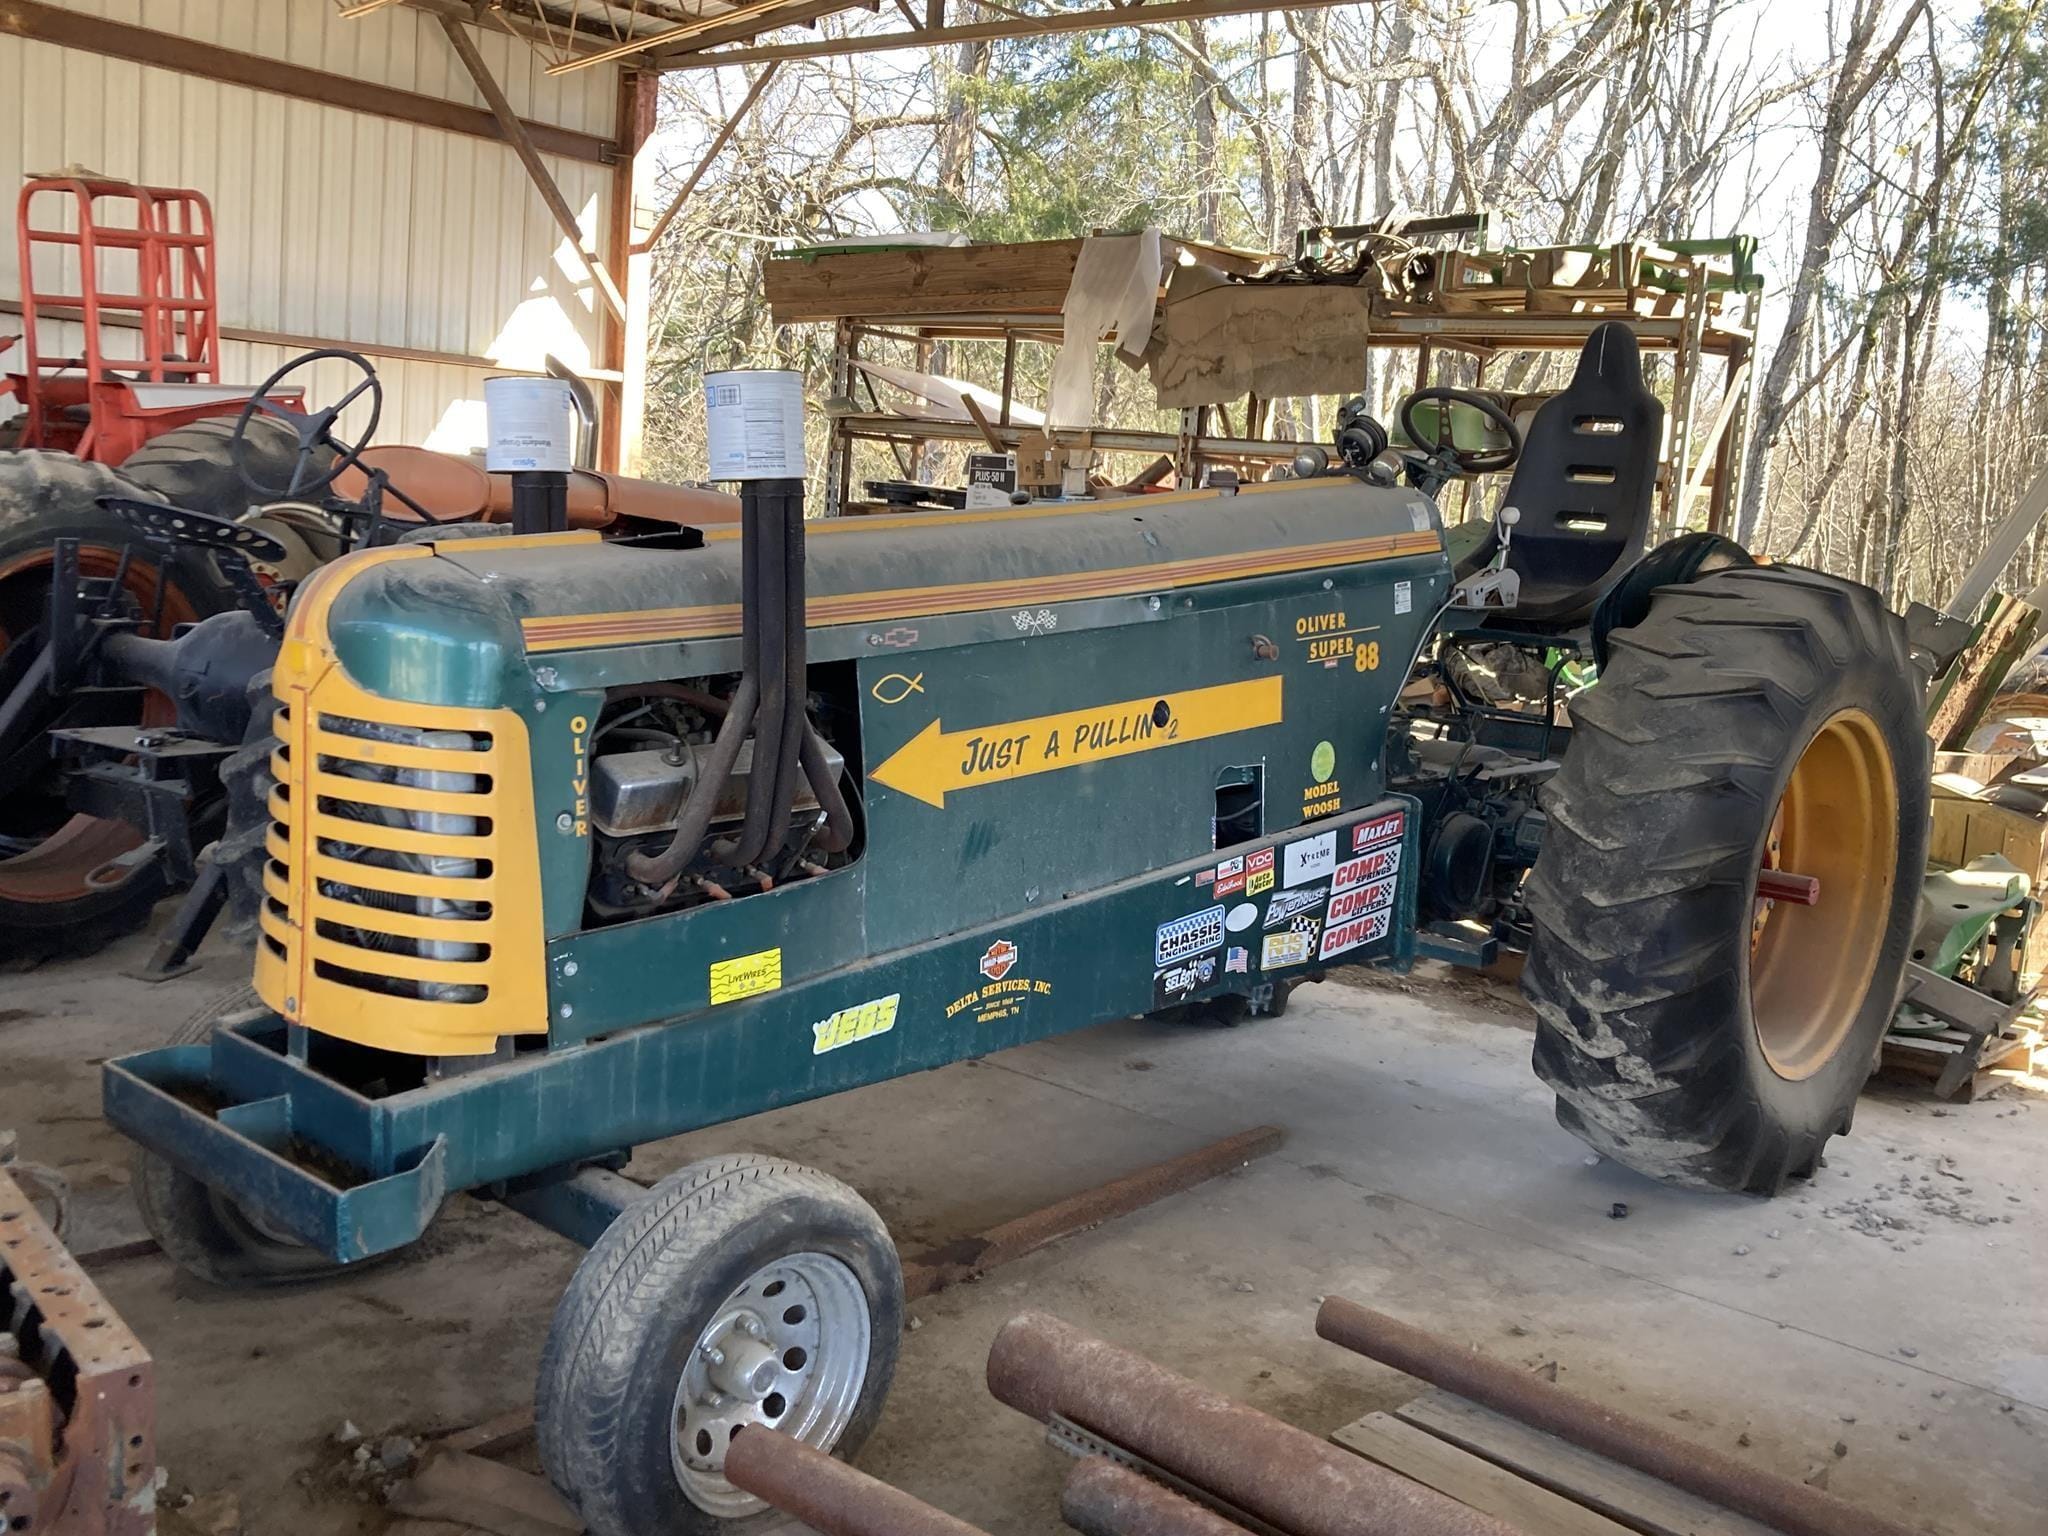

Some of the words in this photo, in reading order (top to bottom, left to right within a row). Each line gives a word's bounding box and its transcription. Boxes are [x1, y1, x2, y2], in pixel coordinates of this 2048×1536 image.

[974, 471, 999, 482] PLUS-50
[1296, 612, 1346, 634] OLIVER
[1310, 637, 1354, 659] SUPER
[1355, 641, 1379, 672] 88
[961, 735, 1030, 775] JUST
[1044, 730, 1059, 759] A
[570, 716, 588, 837] OLIVER
[1304, 781, 1340, 800] MODEL
[1302, 798, 1341, 818] WOOSH
[1248, 852, 1273, 868] VDO
[1335, 853, 1386, 887] COMP
[1356, 864, 1392, 884] SPRINGS
[1330, 885, 1381, 919] COMP
[1352, 897, 1387, 917] LIFTERS
[1160, 921, 1221, 952] CHASSIS
[1160, 933, 1221, 960] ENGINEERING
[1323, 917, 1375, 953] COMP
[1357, 929, 1381, 943] CAMS
[946, 991, 979, 1018] DELTA
[981, 979, 1031, 998] SERVICES,
[1033, 980, 1052, 995] INC.
[816, 996, 898, 1052] JEGS
[977, 1009, 1008, 1023] MEMPHIS,
[1011, 1006, 1020, 1015] TN
